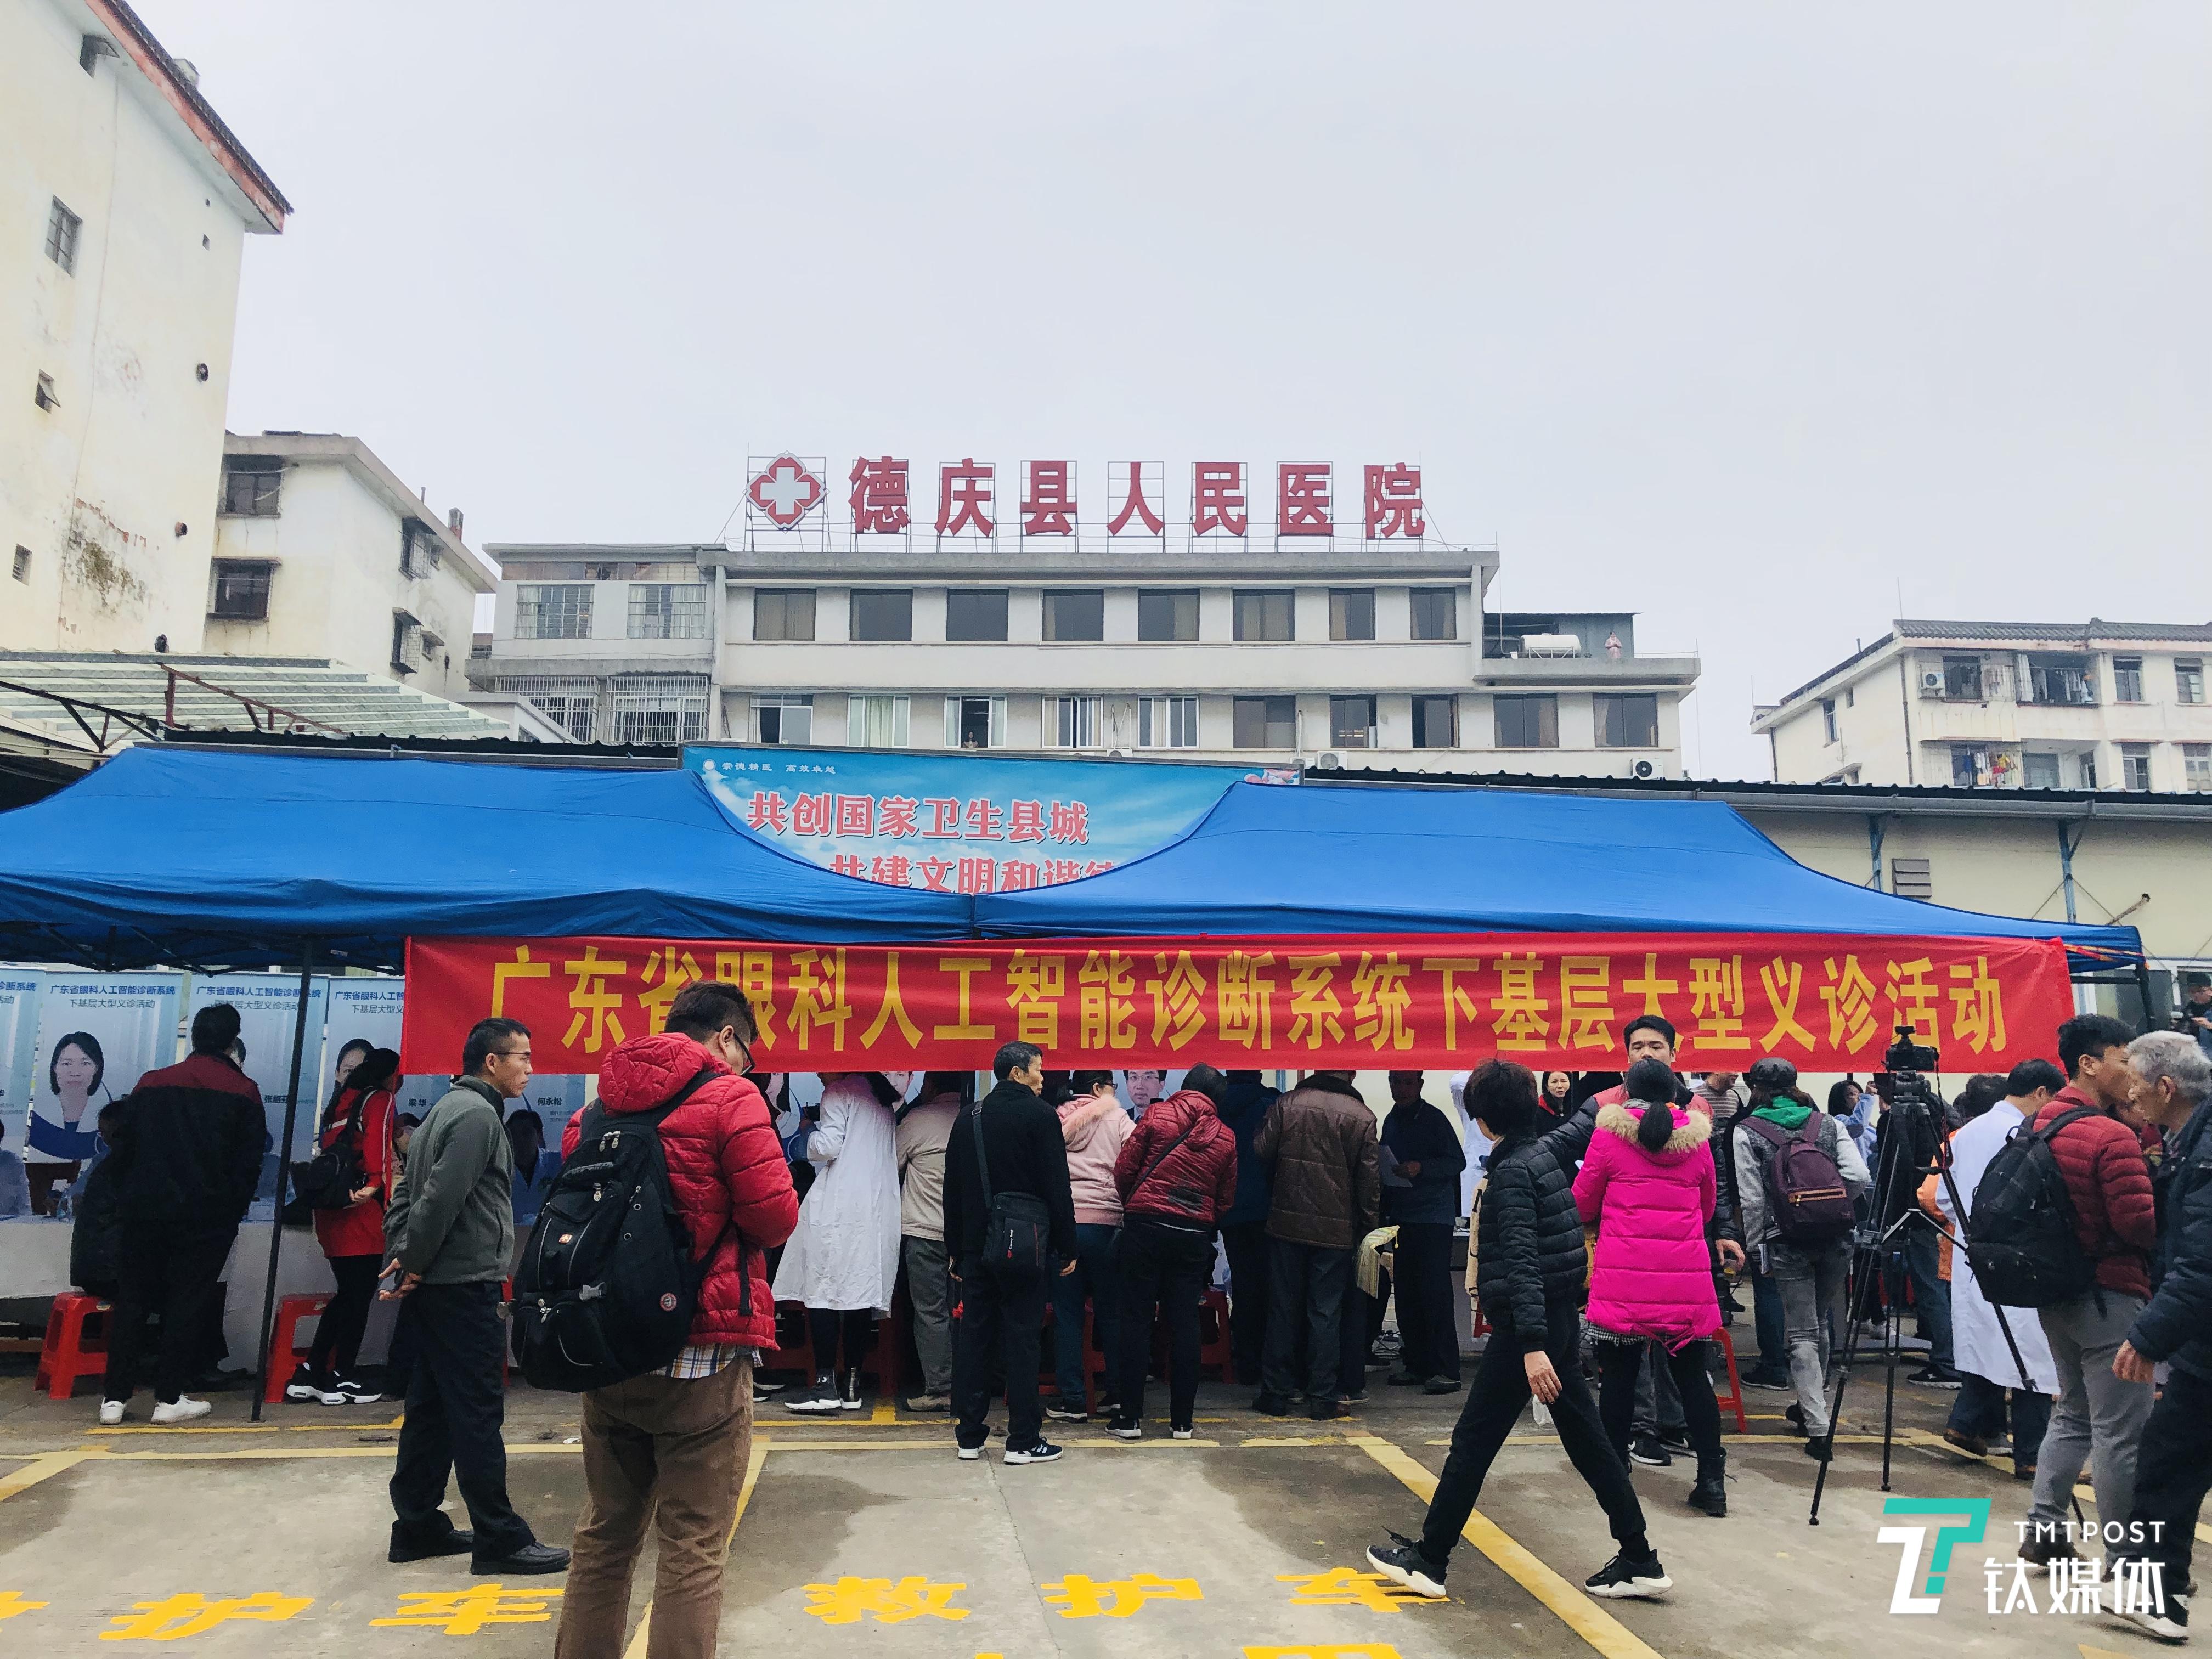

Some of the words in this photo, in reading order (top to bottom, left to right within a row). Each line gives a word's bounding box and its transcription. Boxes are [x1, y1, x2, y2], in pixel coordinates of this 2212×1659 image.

[848, 456, 1425, 539] 德庆县人民医院
[785, 764, 836, 774] 高效卓越
[747, 791, 1088, 843] 共创国家卫生县城
[50, 985, 176, 995] 广东省眼科人工智能诊断系统
[196, 986, 321, 998] 广东省眼科人工智能诊断统
[69, 999, 155, 1008] 下基层大型义诊活动
[492, 946, 2006, 1054] 广东省眼科人工智能诊断系统下基层大型义诊活动
[538, 1097, 562, 1106] 何永松
